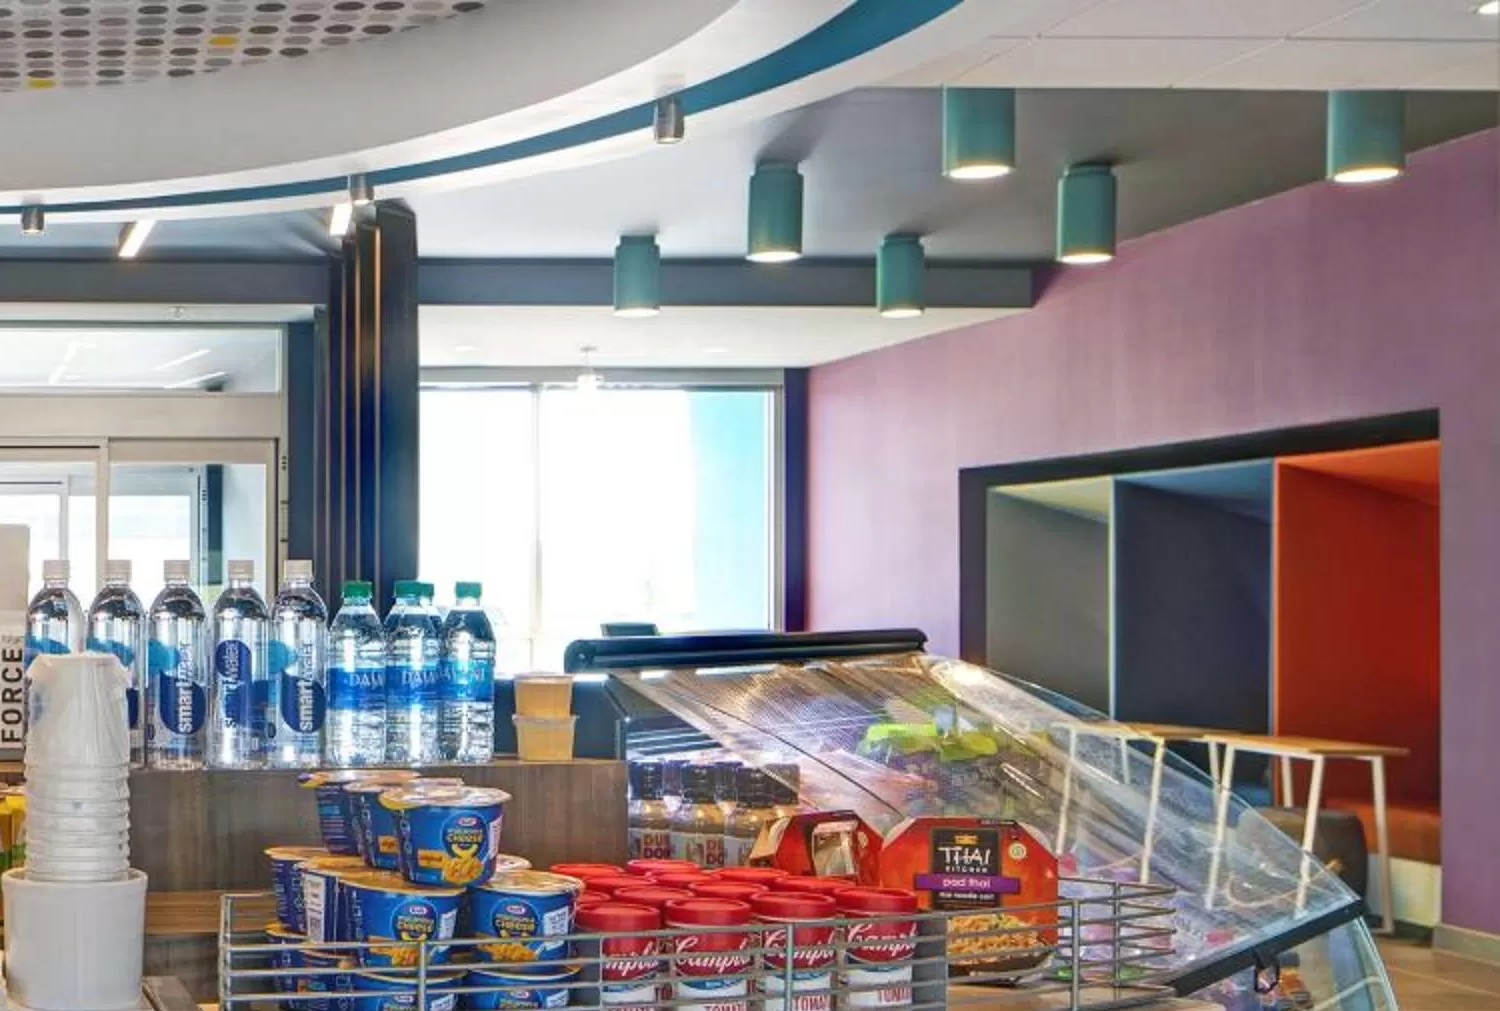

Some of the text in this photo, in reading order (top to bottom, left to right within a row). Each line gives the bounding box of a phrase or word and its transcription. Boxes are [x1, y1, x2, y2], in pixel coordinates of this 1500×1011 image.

[1, 648, 23, 743] FORCE
[937, 846, 992, 865] THAI
[942, 878, 991, 889] pad thai
